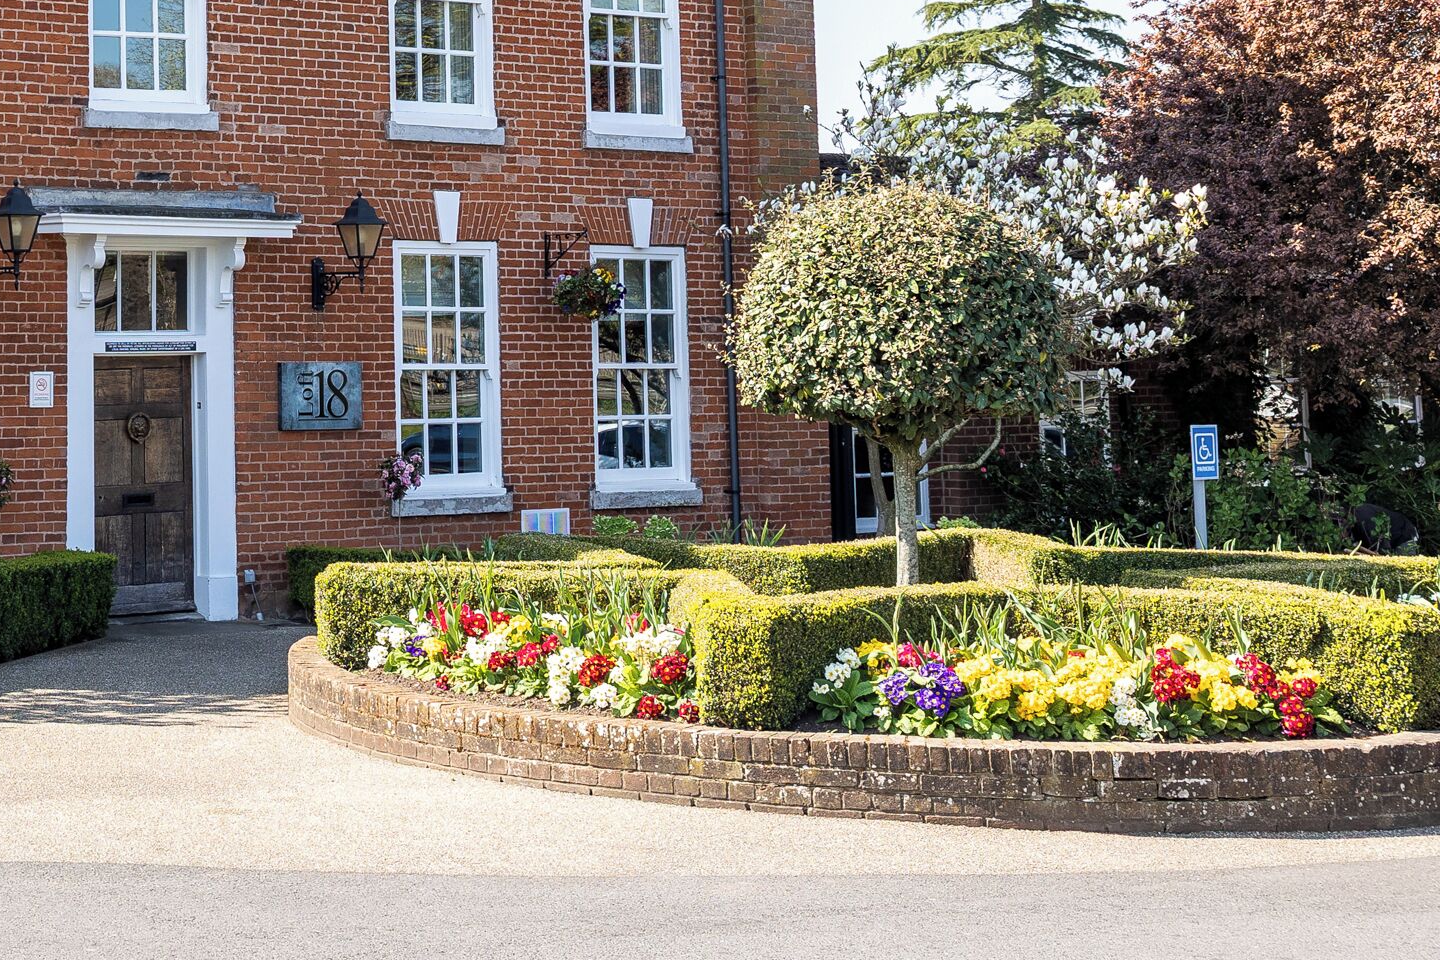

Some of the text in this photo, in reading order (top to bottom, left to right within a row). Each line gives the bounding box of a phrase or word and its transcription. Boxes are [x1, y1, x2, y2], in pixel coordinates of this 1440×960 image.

[296, 369, 349, 418] Loft 18
[1196, 465, 1216, 473] PARKING
